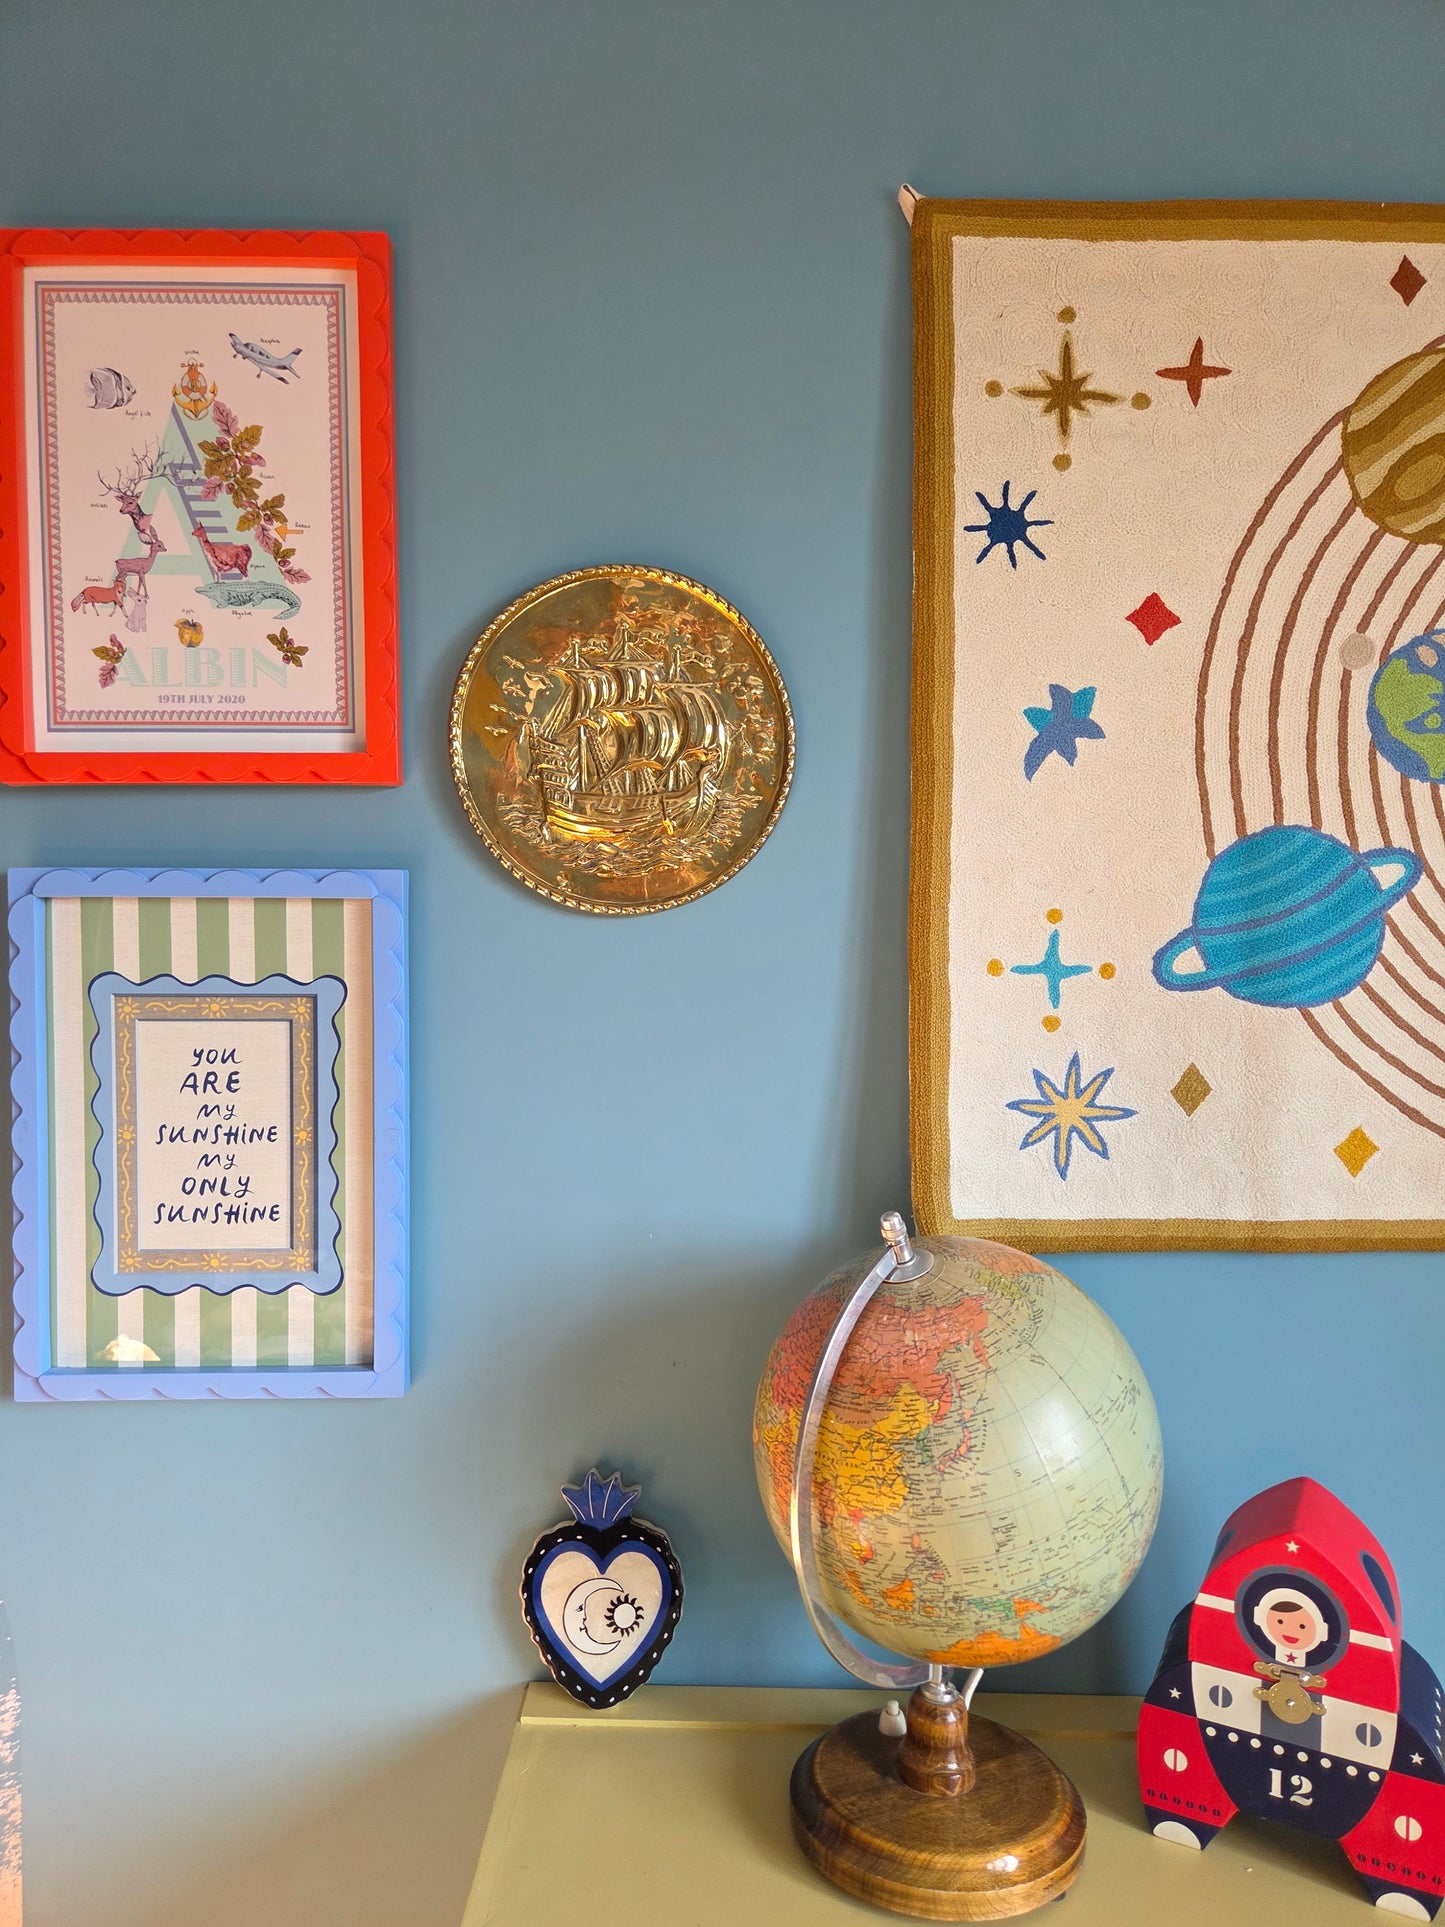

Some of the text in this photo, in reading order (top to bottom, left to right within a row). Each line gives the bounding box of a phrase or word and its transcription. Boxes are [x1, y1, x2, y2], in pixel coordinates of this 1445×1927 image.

[115, 646, 288, 689] ALBIN
[157, 694, 246, 705] 19TH JULY 2020
[179, 1070, 241, 1095] ARE
[181, 1175, 254, 1198] ONLY
[1268, 1768, 1313, 1806] 12
